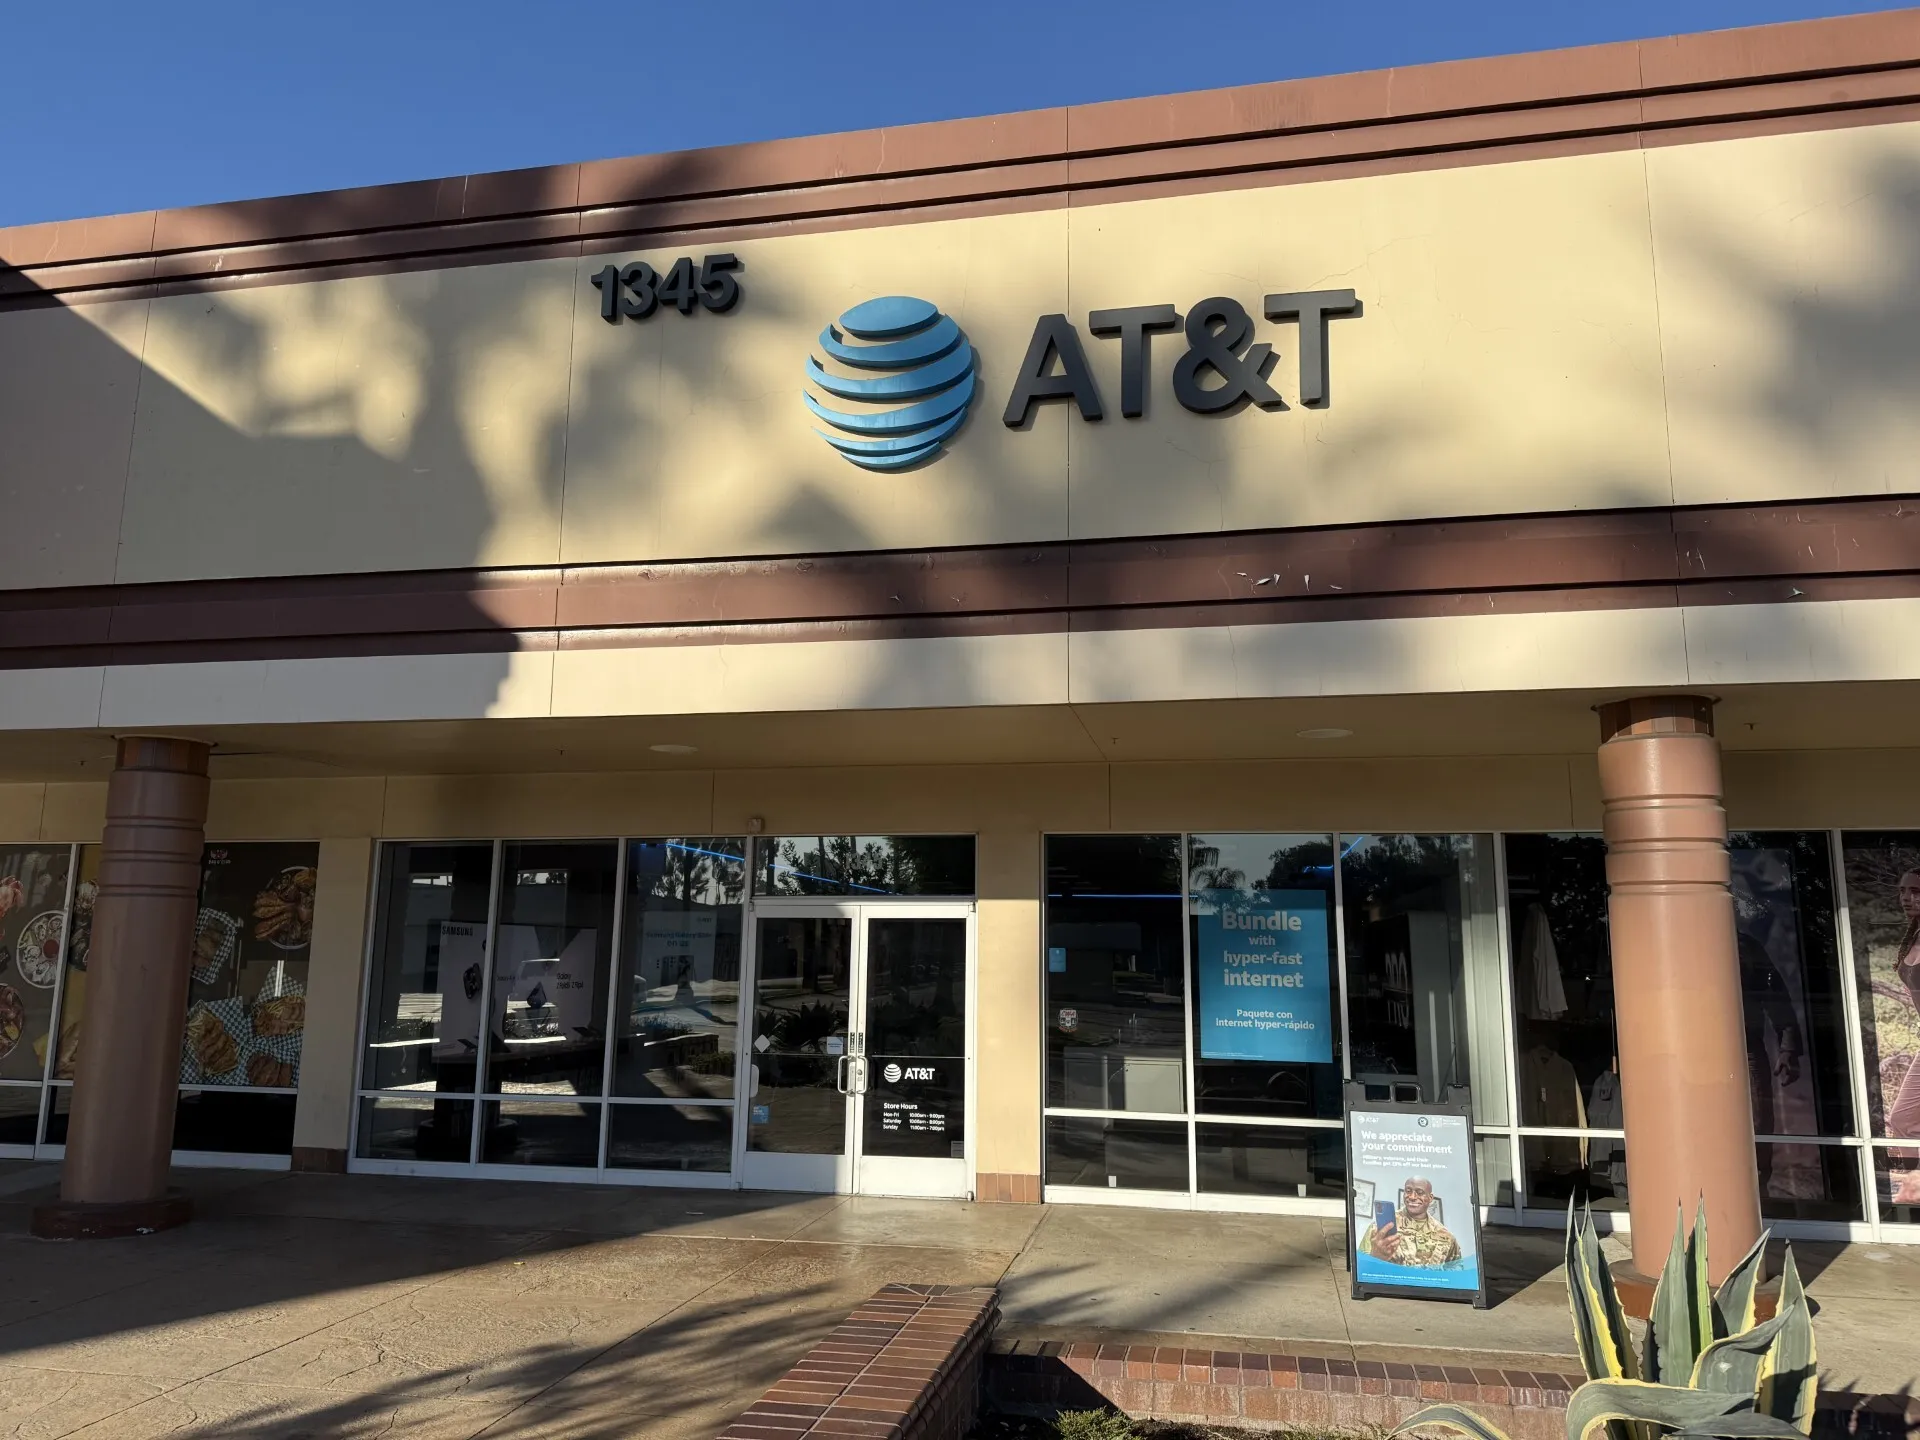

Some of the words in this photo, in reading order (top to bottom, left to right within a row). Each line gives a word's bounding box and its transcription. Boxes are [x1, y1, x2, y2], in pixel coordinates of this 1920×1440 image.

[590, 252, 740, 323] 1345
[1003, 288, 1360, 428] AT&T
[1222, 910, 1302, 931] Bundle
[441, 925, 474, 937] SAMSUNG
[1248, 934, 1276, 946] with
[1223, 950, 1303, 967] hyper-fast
[1223, 968, 1304, 988] internet
[1236, 1009, 1274, 1019] Paquete
[1276, 1011, 1293, 1019] con
[1254, 1019, 1315, 1031] hyper-rápido
[904, 1067, 936, 1080] AT&T
[883, 1102, 900, 1110] Store
[1361, 1130, 1377, 1140] We
[1378, 1132, 1433, 1143] appreciate
[1361, 1142, 1385, 1152] your
[1386, 1143, 1453, 1154] commitment
